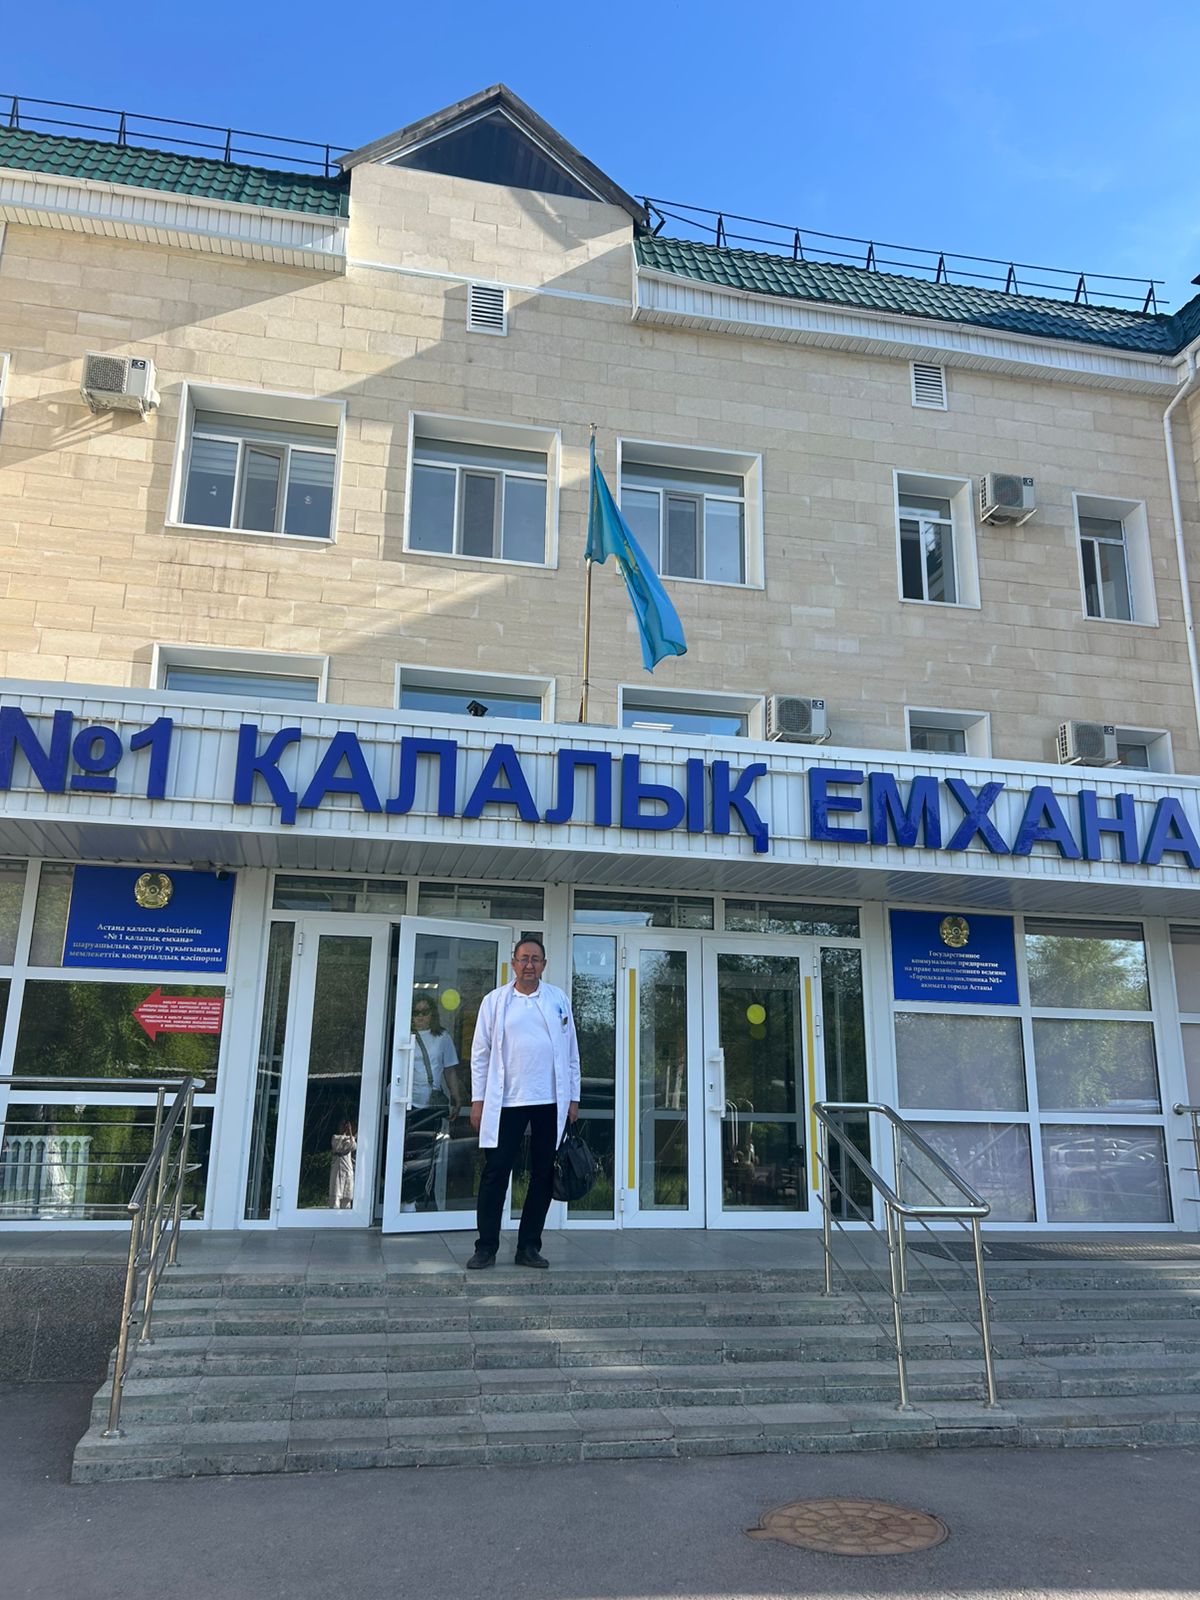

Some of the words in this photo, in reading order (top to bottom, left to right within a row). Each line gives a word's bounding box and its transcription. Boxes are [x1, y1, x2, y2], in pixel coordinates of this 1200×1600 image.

[0, 706, 173, 801] №1
[233, 724, 768, 854] ҚАЛАЛЫҚ
[808, 767, 1200, 870] ЕМХАНА
[69, 950, 120, 958] мемлекеттік
[180, 954, 223, 963] кәсіпорны
